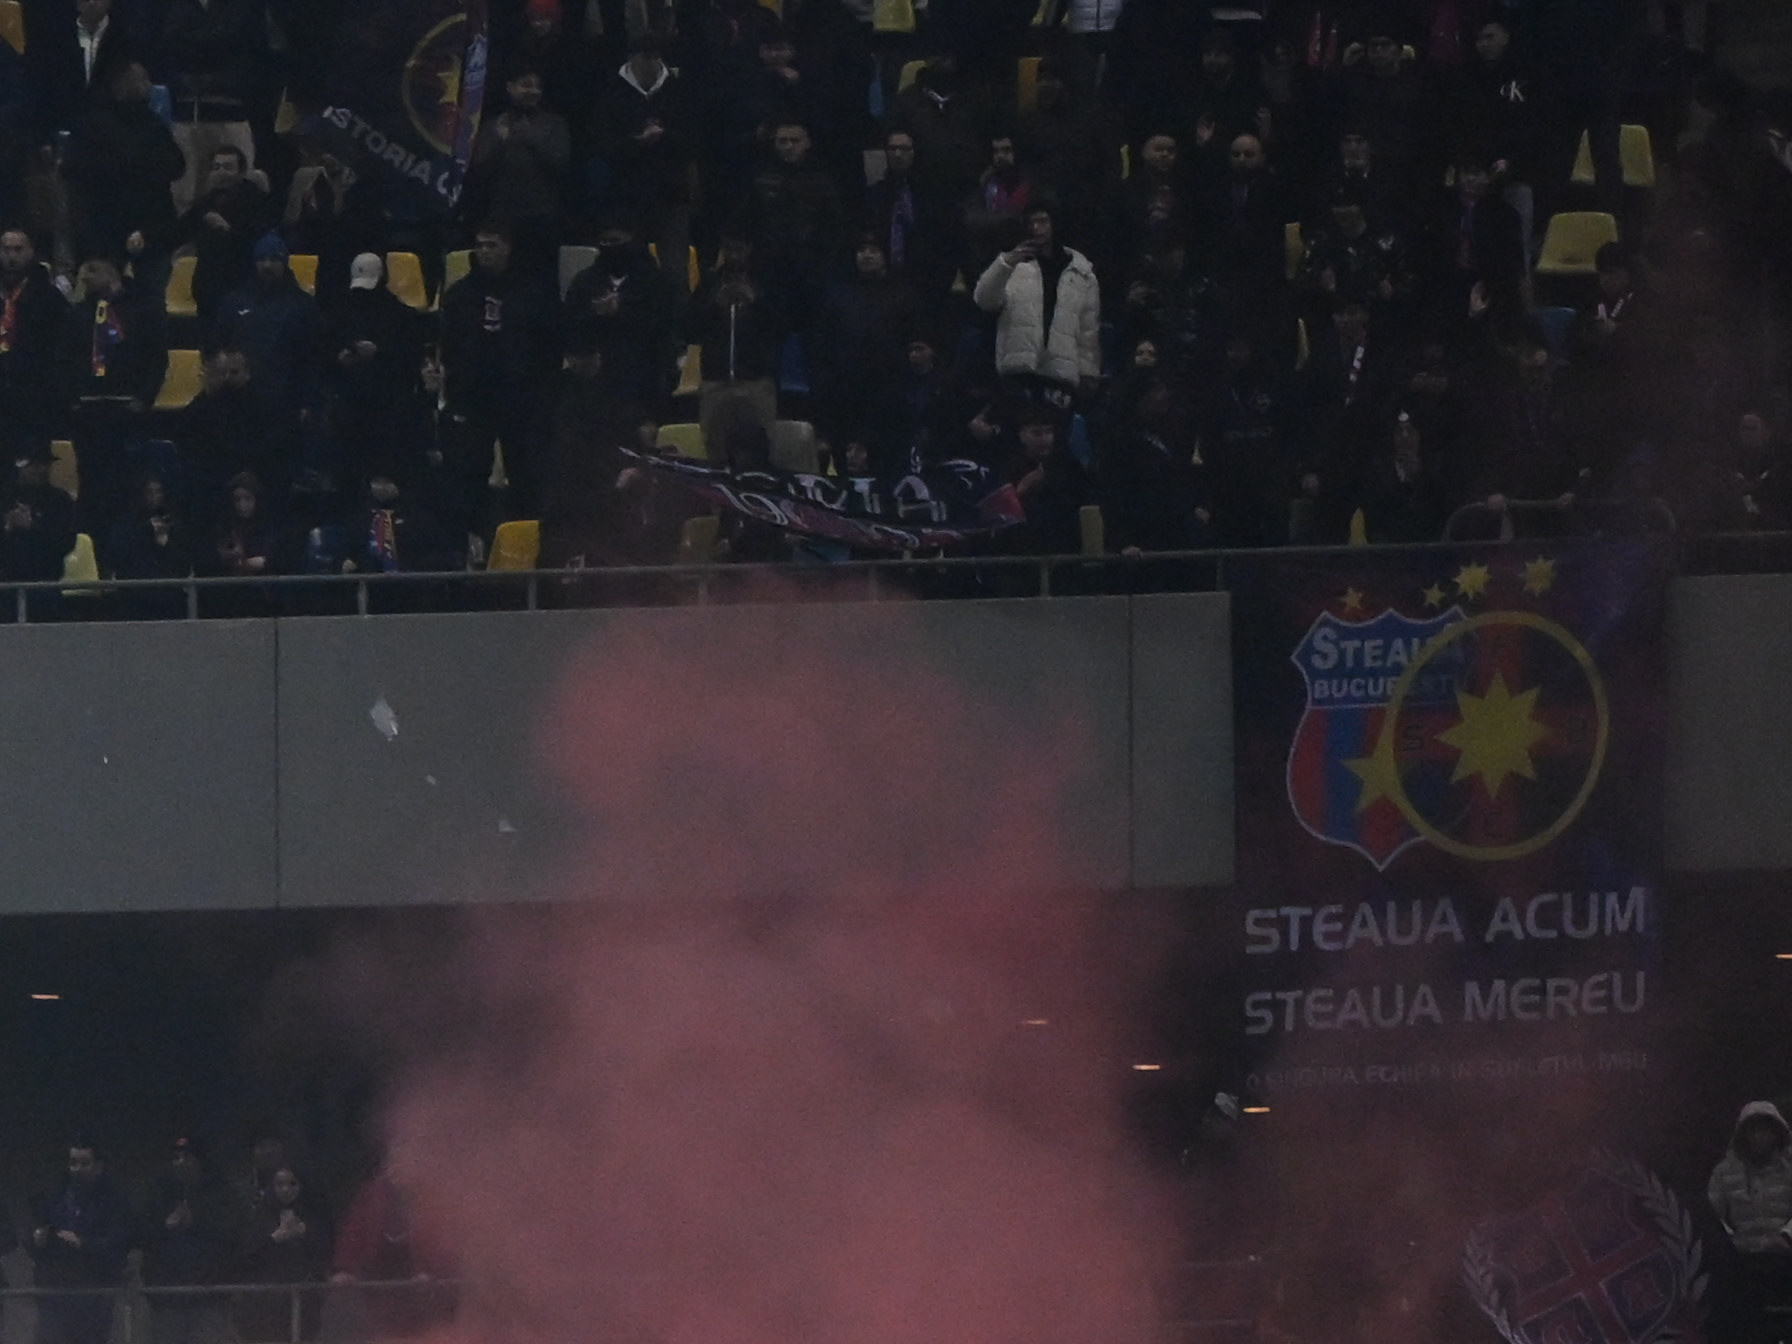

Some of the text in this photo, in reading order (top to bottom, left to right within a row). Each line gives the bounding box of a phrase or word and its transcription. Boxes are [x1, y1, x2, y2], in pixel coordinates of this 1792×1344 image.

[1245, 886, 1647, 955] STEAUA ACUM
[1245, 970, 1647, 1036] STEAUA MEREU
